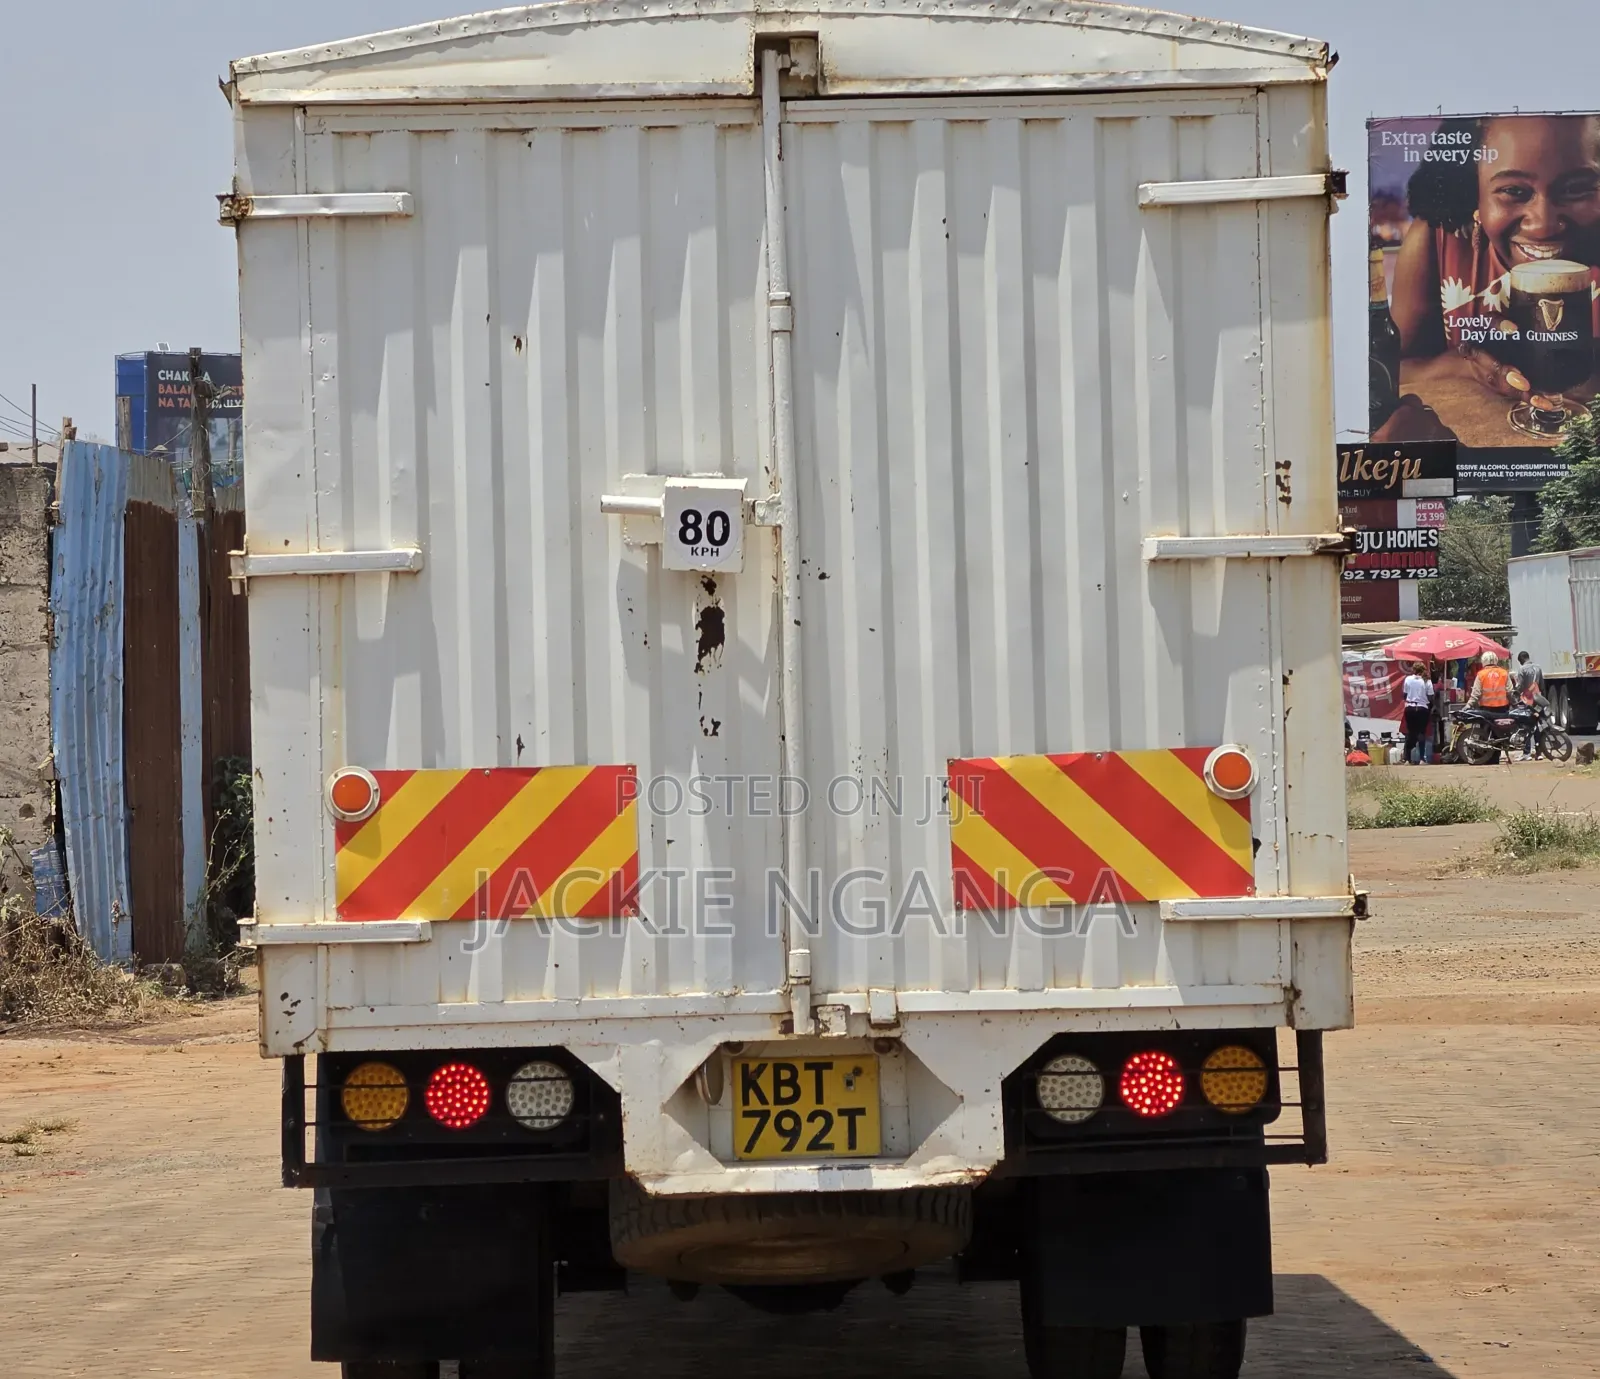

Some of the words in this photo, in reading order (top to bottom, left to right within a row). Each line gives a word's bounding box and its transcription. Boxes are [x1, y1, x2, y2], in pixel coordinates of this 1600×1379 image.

[1381, 131, 1427, 146] Extra
[1430, 130, 1472, 145] taste
[1403, 146, 1420, 162] in
[1423, 149, 1471, 164] every
[1473, 145, 1499, 163] sip
[1449, 314, 1493, 329] Lovely
[1461, 329, 1487, 343] Day
[1489, 327, 1510, 341] for
[1511, 332, 1520, 341] a
[1526, 329, 1579, 342] GUINNESS
[158, 397, 175, 408] NA
[1480, 463, 1510, 471] ALCOHOL
[1510, 463, 1559, 471] CONSUMPTION
[1515, 470, 1546, 478] PERSONS
[678, 508, 731, 547] 80
[1386, 528, 1439, 549] HOMES
[690, 546, 720, 557] KPH
[1369, 569, 1402, 579] 792
[1406, 567, 1439, 578] 792
[1444, 639, 1464, 648] 5G
[1371, 662, 1393, 704] GET
[741, 1062, 834, 1106] KBT
[742, 1107, 866, 1153] 792T
